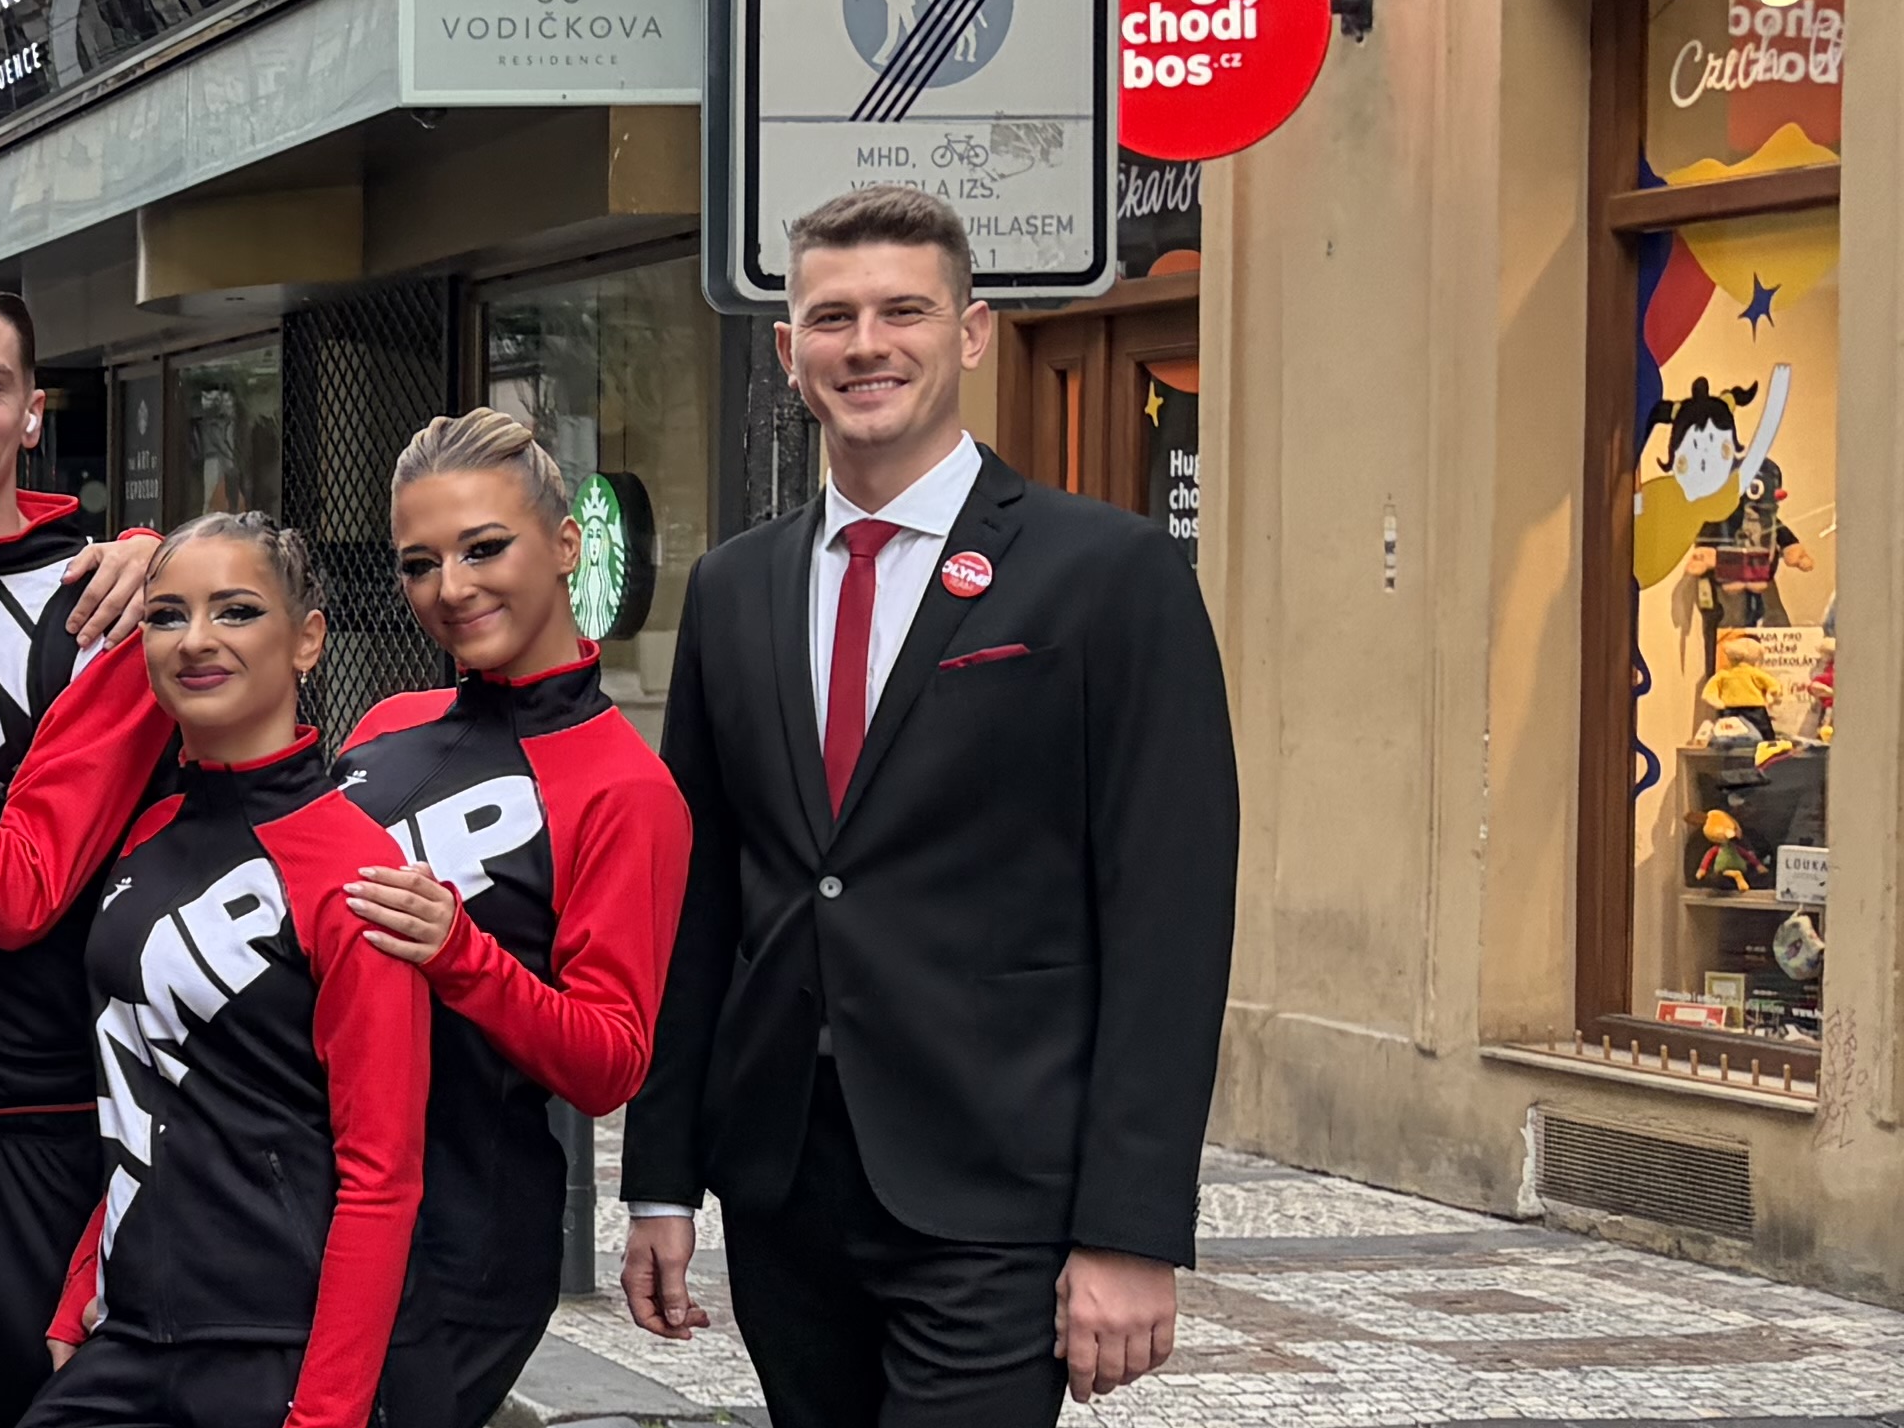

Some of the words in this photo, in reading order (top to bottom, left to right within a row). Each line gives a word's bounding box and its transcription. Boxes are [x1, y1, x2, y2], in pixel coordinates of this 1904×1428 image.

[442, 10, 663, 41] VODIČKOVA
[498, 55, 620, 67] RESIDENCE
[857, 147, 917, 169] MHD,
[966, 215, 1074, 237] UHLASEM
[1169, 482, 1200, 510] cho
